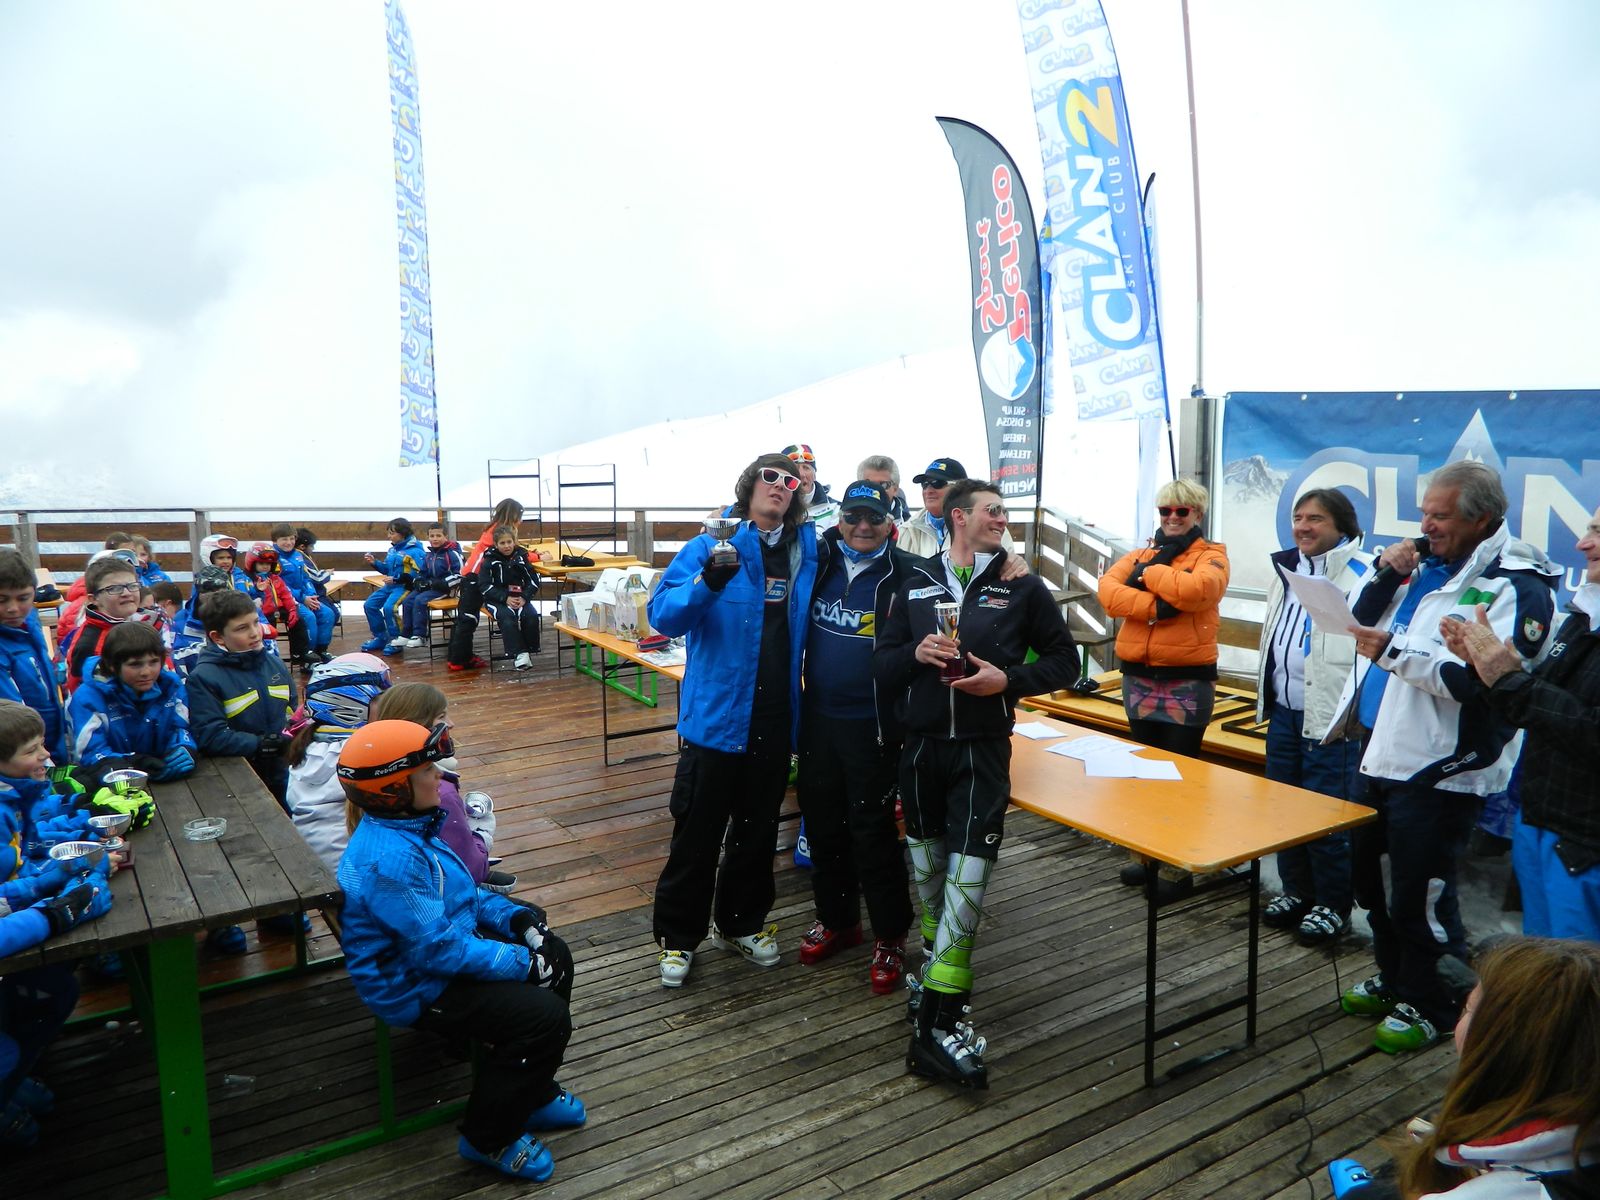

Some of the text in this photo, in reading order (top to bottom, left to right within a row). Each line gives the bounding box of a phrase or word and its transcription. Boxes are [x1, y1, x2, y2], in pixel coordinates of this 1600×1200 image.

[1107, 155, 1126, 214] CLUB
[1065, 86, 1142, 343] CLAN2
[1122, 253, 1135, 288] SKI
[1100, 353, 1155, 384] CLAN2
[849, 484, 881, 500] CLAN2
[812, 599, 875, 635] CLAN2
